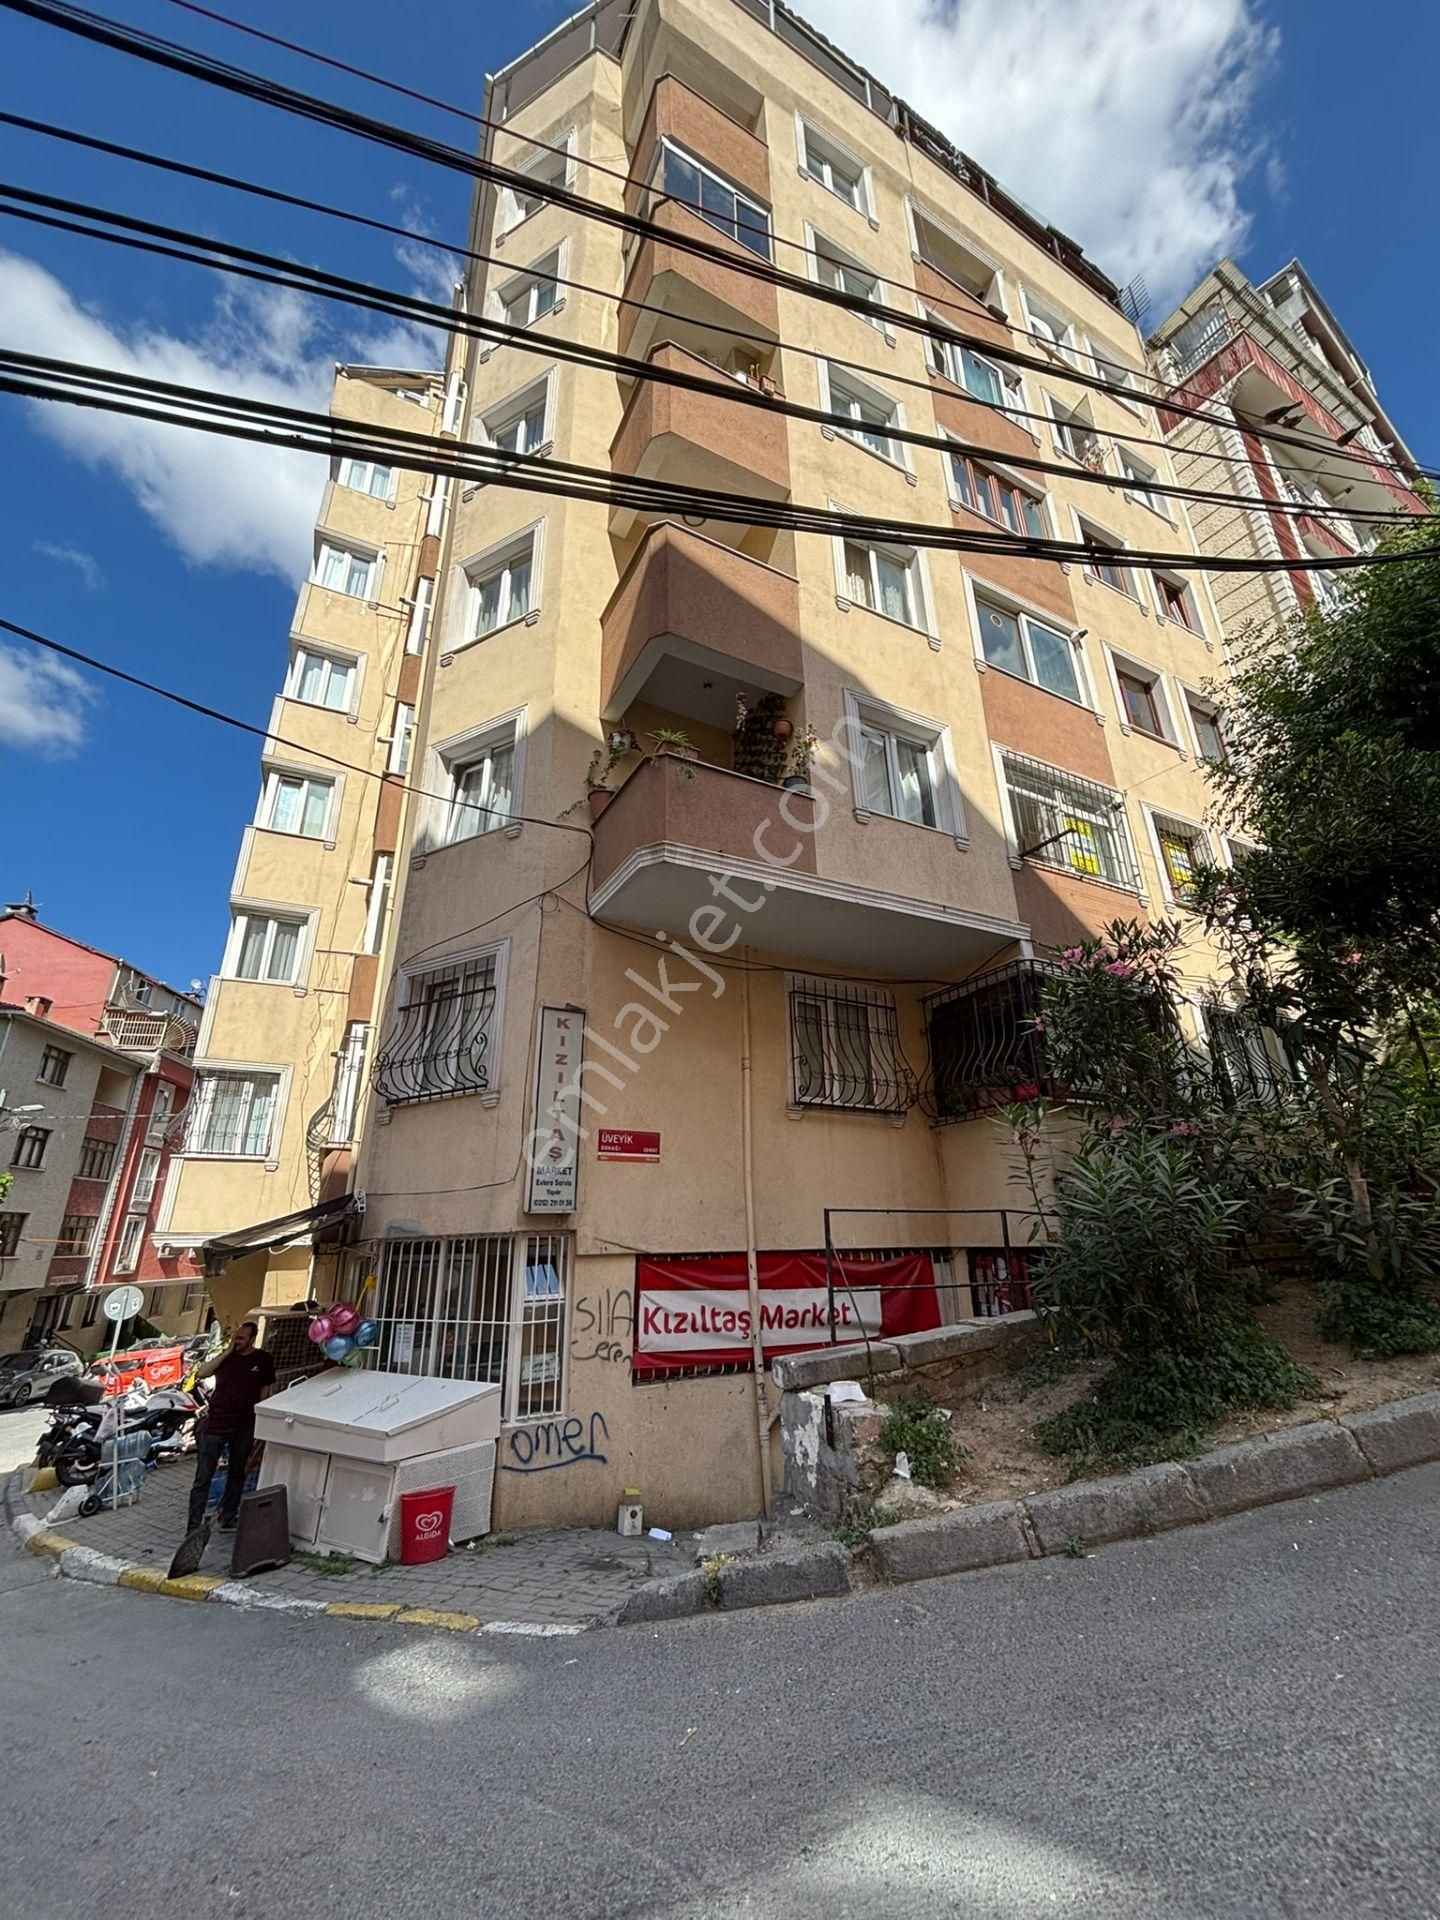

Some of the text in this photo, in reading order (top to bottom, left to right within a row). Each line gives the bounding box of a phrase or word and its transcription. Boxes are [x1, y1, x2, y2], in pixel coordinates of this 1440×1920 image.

[601, 1132, 634, 1144] ÜVEYİK
[536, 1167, 573, 1176] MARKET
[643, 1302, 852, 1340] Kızıltaş Market
[415, 1530, 442, 1541] ALGIDA
